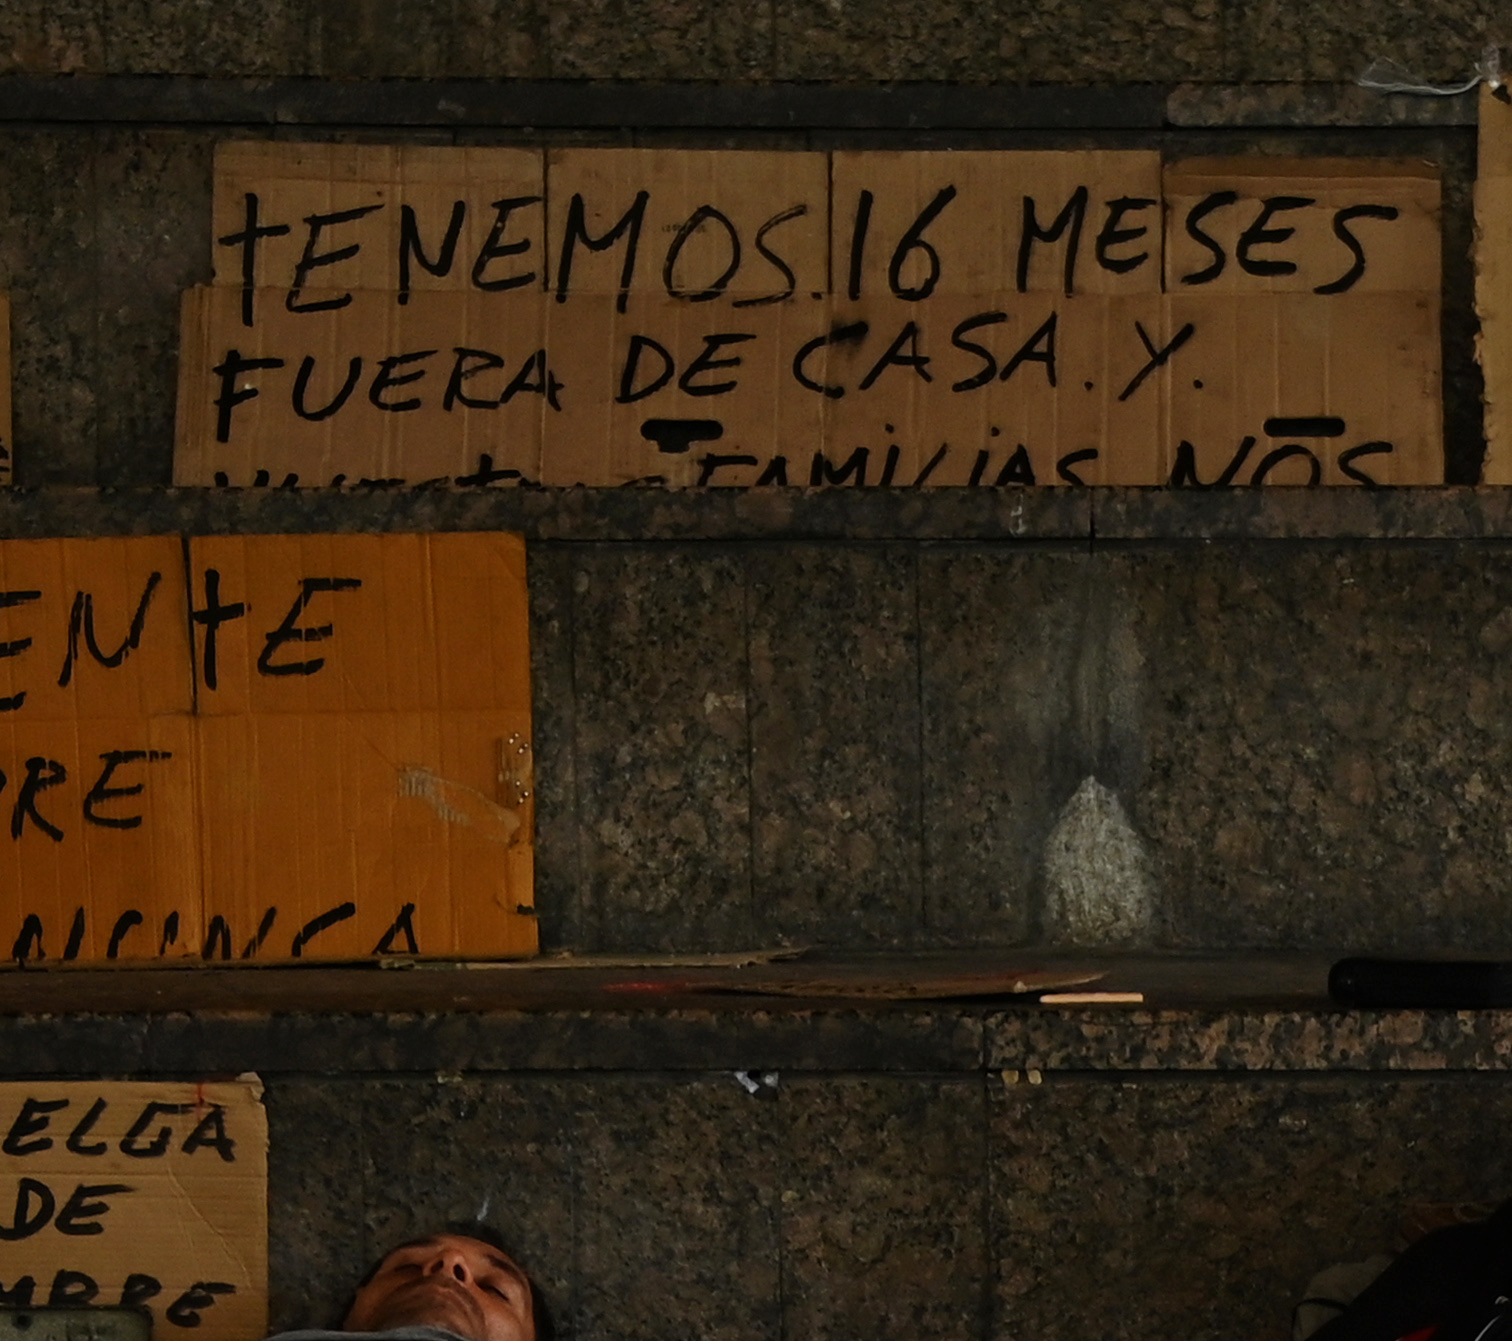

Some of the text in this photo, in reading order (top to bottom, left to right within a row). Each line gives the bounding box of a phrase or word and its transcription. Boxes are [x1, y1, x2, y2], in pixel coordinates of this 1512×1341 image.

[848, 184, 957, 301] 16
[1015, 184, 1399, 298] MESES
[212, 348, 564, 443] FUERA
[614, 333, 757, 403] DE
